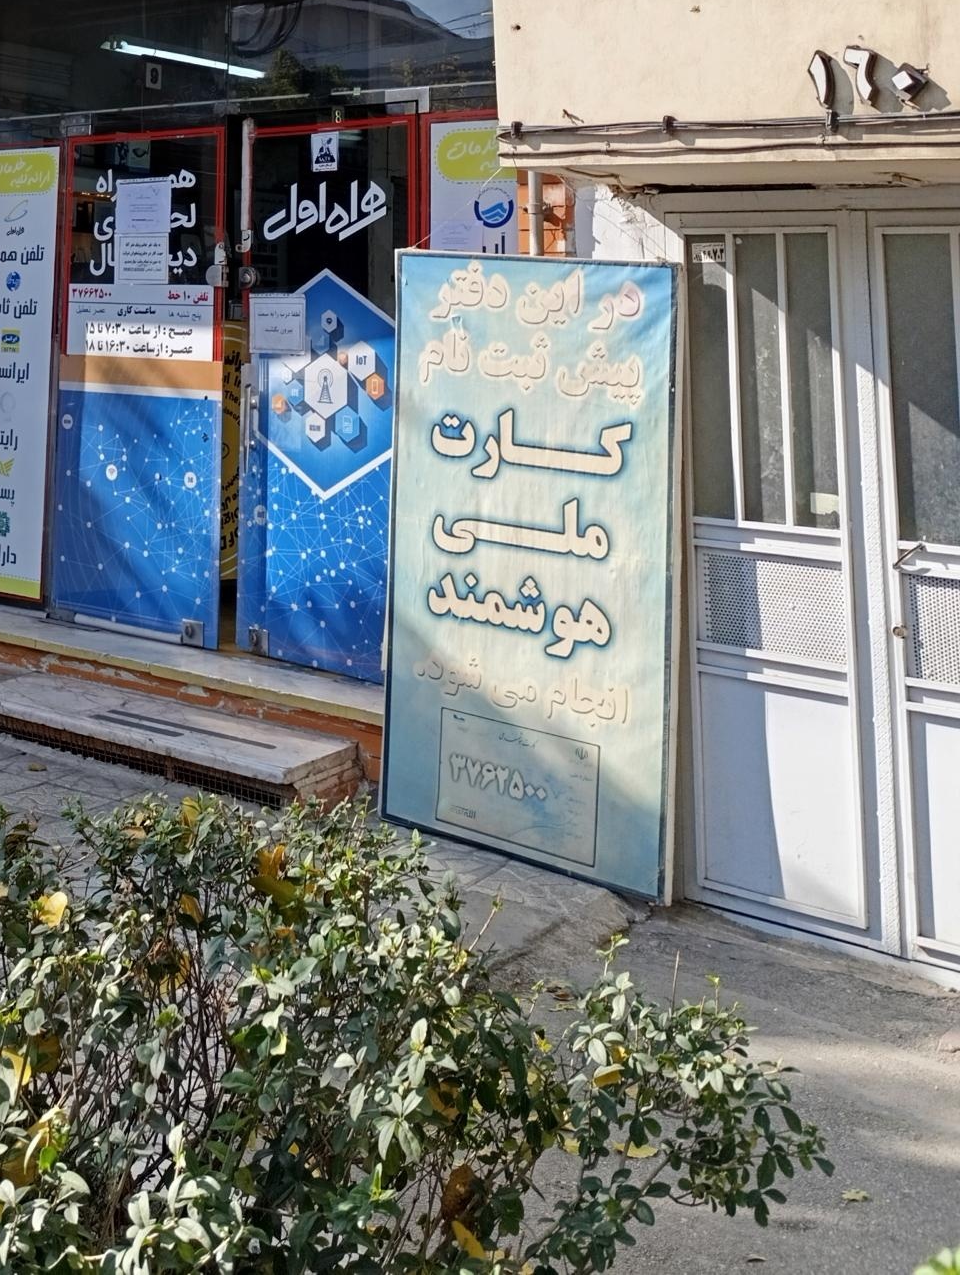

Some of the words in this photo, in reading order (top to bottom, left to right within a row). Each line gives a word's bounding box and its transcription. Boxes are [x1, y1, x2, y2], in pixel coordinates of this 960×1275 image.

[263, 181, 326, 241] اول
[325, 179, 387, 242] همراه
[20, 244, 45, 265] تلفن
[13, 298, 38, 319] تلفن
[192, 292, 209, 304] تلفن
[431, 262, 509, 320] دفتر
[518, 269, 583, 326] این
[592, 281, 643, 331] در
[128, 325, 151, 335] ساعت
[355, 355, 368, 366] IoT
[419, 331, 470, 384] نام
[479, 335, 548, 391] ثبت
[557, 345, 642, 405] پیش
[431, 408, 634, 479] کارت
[431, 498, 611, 560] ملی
[427, 573, 613, 659] هوشمند
[492, 684, 538, 710] می
[546, 676, 630, 729] انجام
[448, 753, 548, 802] ۳۷۶۲۵۰۰
